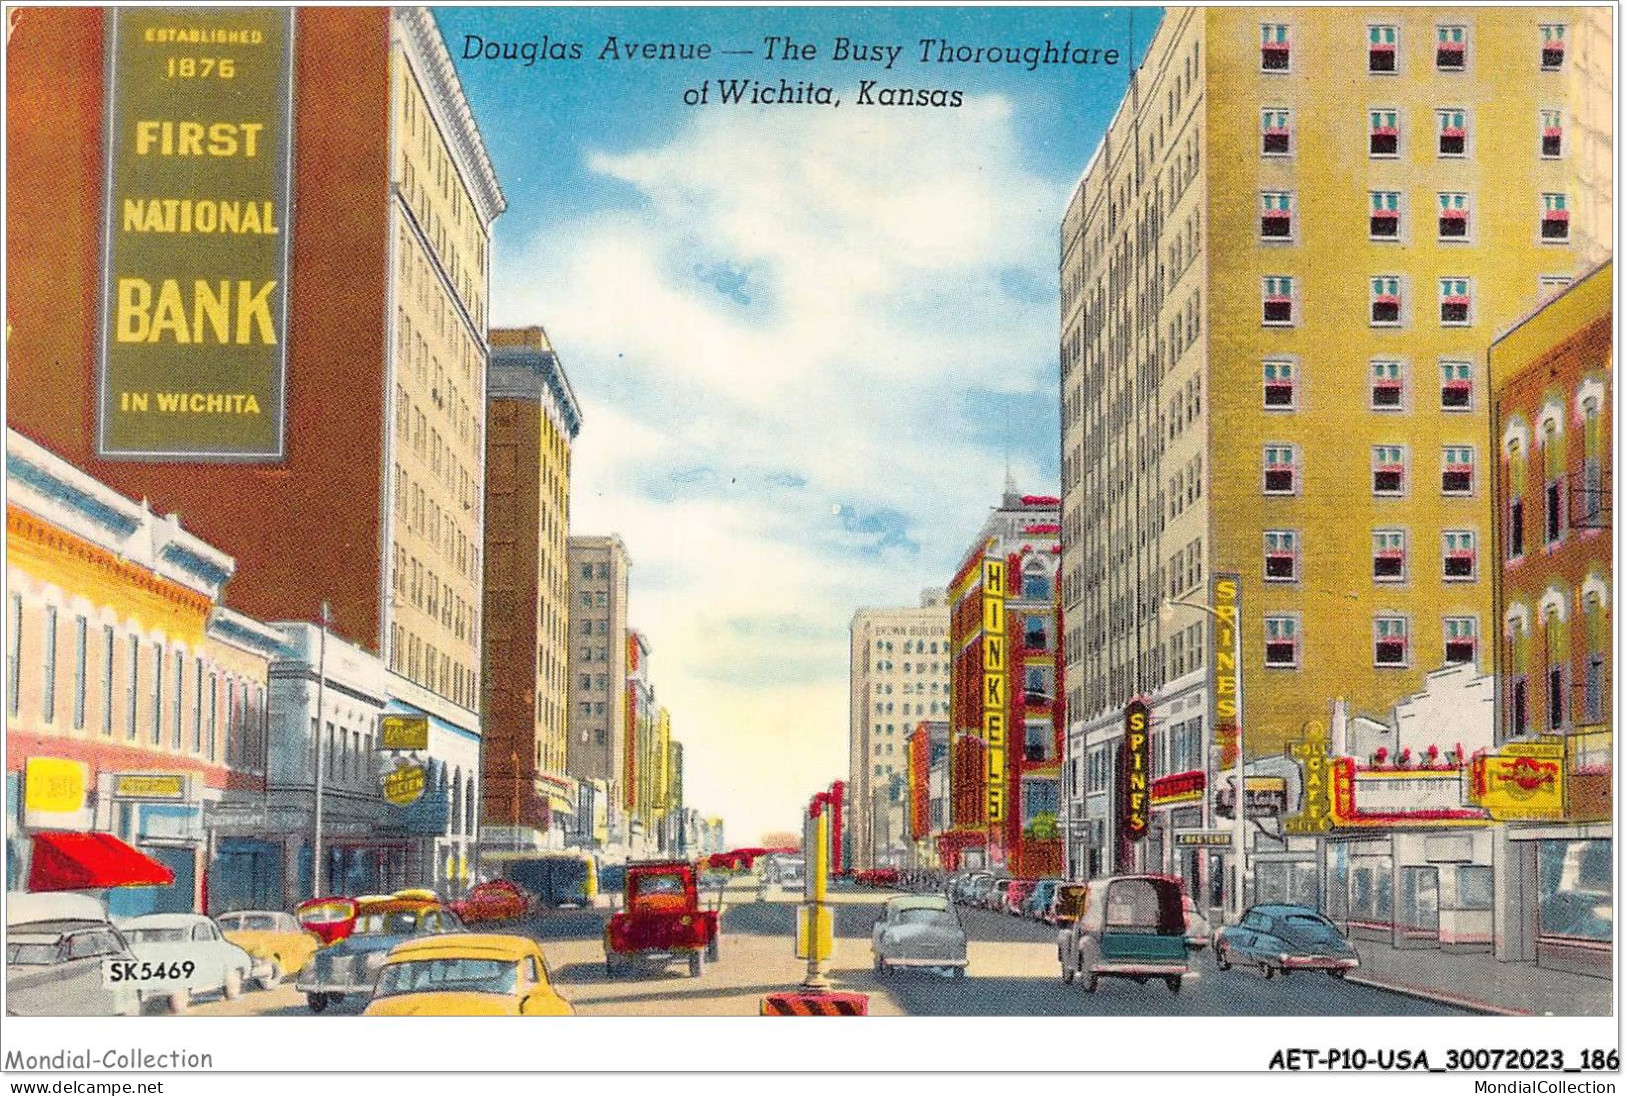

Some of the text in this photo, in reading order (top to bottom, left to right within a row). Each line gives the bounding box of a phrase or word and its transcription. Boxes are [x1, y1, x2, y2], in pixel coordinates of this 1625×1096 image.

[144, 28, 263, 44] ESTABLISHED
[167, 58, 235, 79] 1876
[136, 121, 263, 157] FIRST
[123, 199, 278, 235] NATIONAL
[116, 278, 278, 345] BANK
[120, 392, 261, 415] IN WICHITA
[909, 626, 948, 637] BUILDIN
[1216, 580, 1237, 718] SPINES
[986, 563, 1002, 818] HINKELS
[1129, 712, 1145, 831] SPINES
